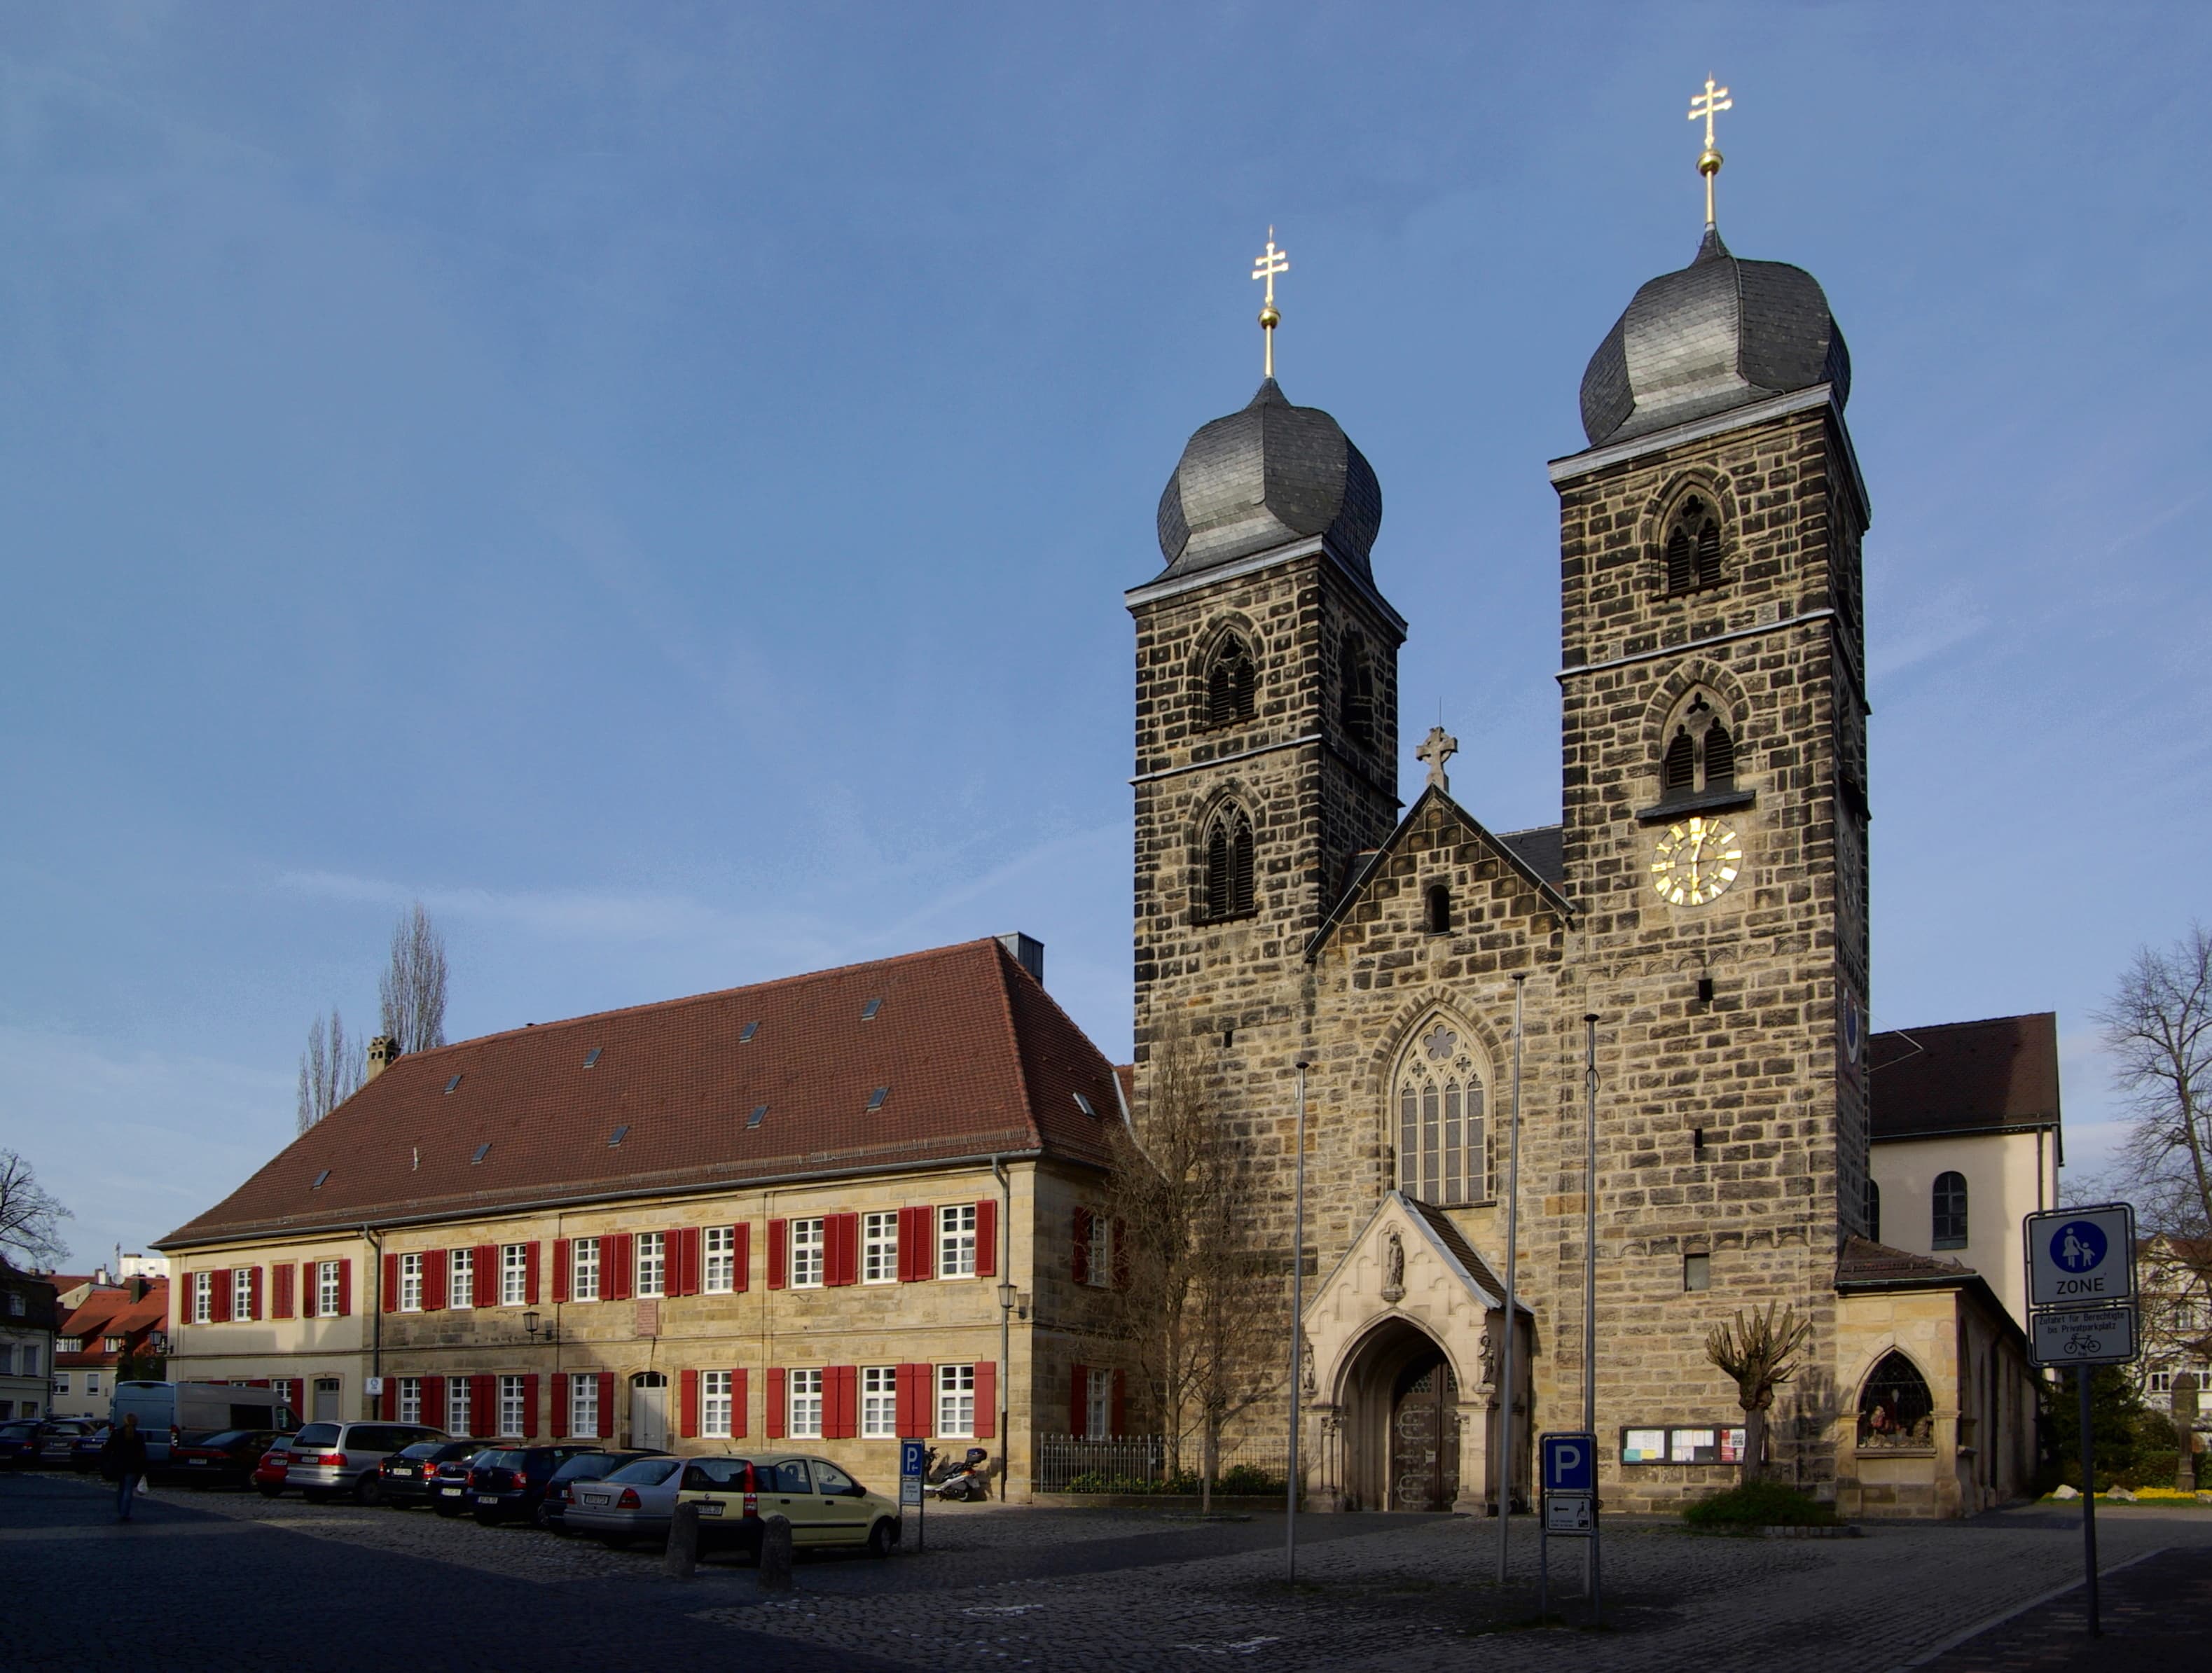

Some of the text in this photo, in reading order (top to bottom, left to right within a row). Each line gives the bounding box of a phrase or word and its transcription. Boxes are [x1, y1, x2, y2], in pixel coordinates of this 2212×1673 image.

[2057, 1277, 2105, 1295] ZONE
[2039, 1310, 2124, 1325] Zufahrt für Berechtigte
[2047, 1321, 2117, 1334] bis Privatparkplatz
[907, 1447, 918, 1472] P
[1555, 1445, 1581, 1483] P
